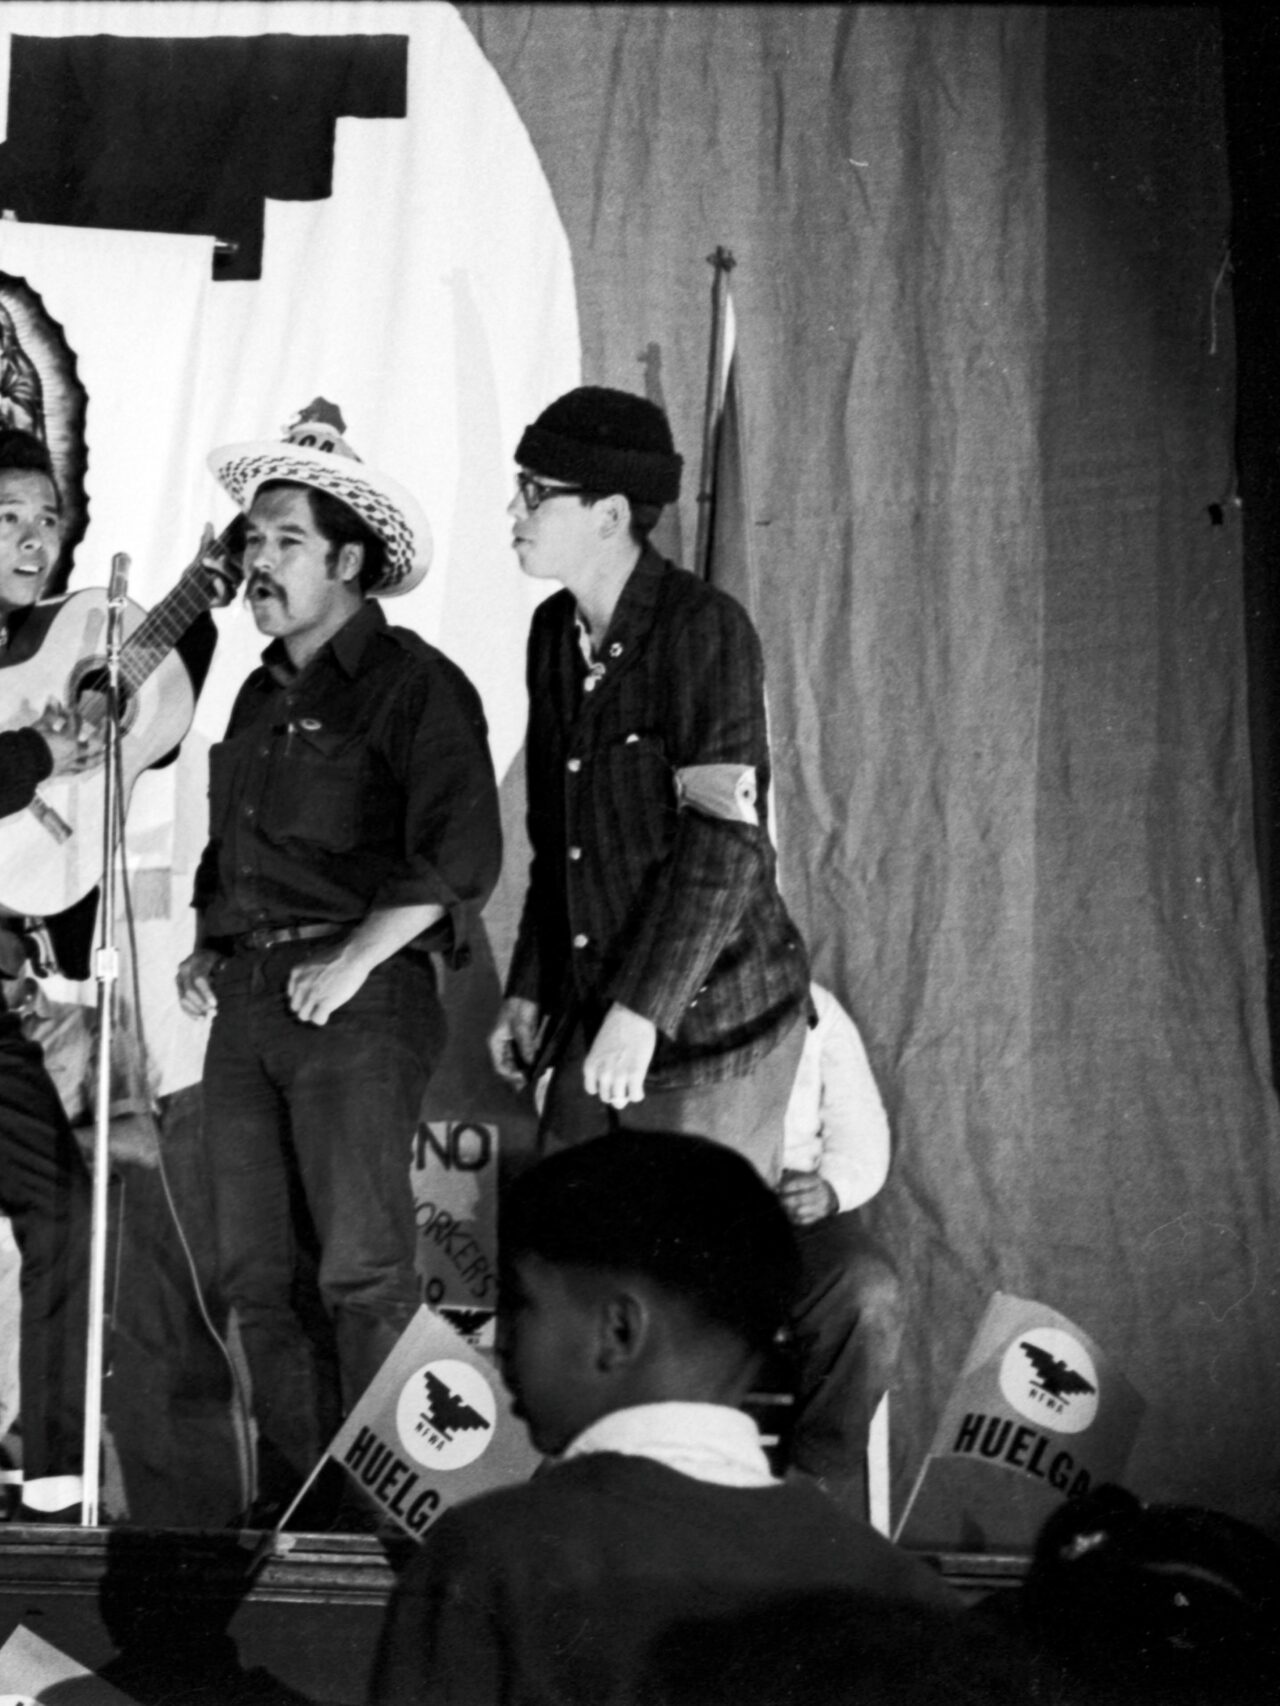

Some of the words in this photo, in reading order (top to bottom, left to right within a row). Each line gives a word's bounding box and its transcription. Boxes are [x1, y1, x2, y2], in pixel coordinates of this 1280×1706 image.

[417, 1122, 491, 1171] NO
[414, 1202, 494, 1298] ORKERS
[415, 1422, 445, 1451] NFWA
[344, 1425, 440, 1533] HUELG
